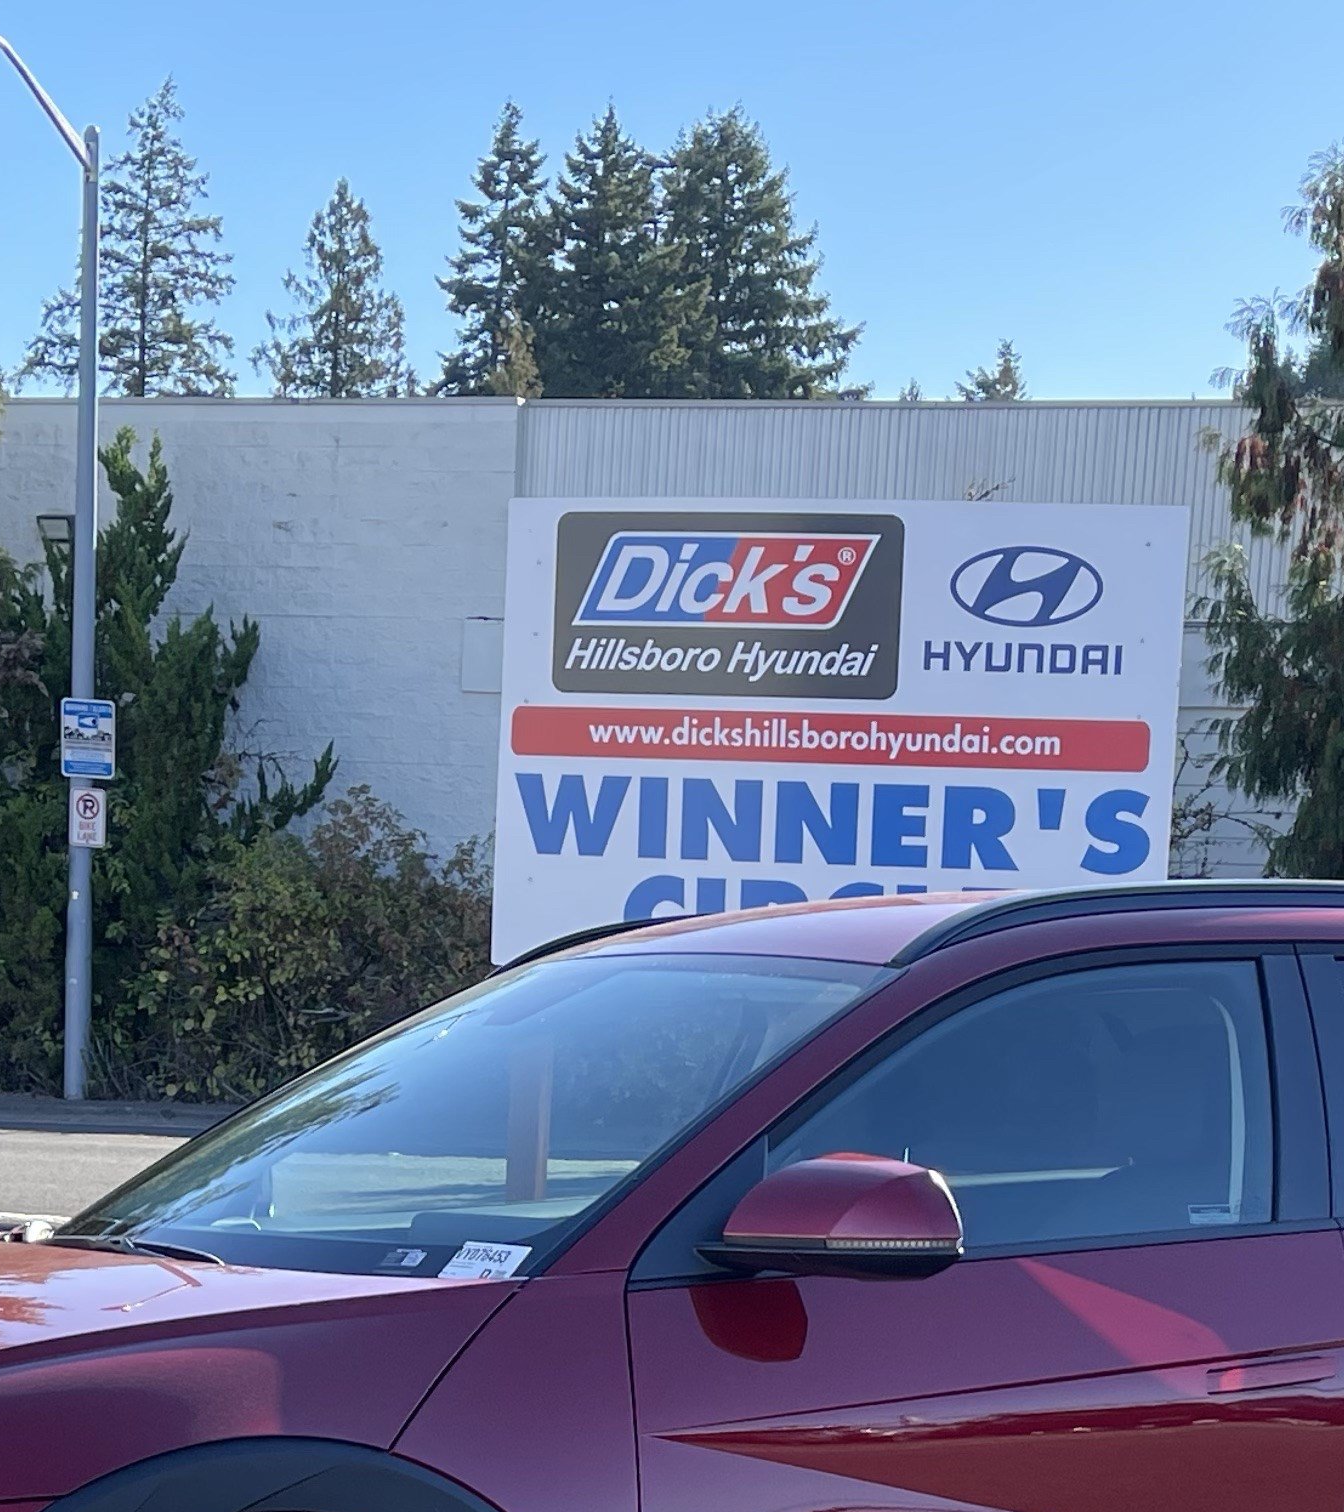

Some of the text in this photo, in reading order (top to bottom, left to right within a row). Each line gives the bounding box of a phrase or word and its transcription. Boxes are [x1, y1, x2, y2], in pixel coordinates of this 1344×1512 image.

[596, 542, 840, 618] Dick's
[565, 638, 880, 682] Hillsboro Hyundai
[925, 641, 1122, 675] HYUNDAI
[588, 717, 1062, 756] www.dickshillsborohyundai.com
[76, 831, 98, 842] LANE
[79, 820, 97, 832] BIKE
[515, 772, 1152, 876] WINNER'S
